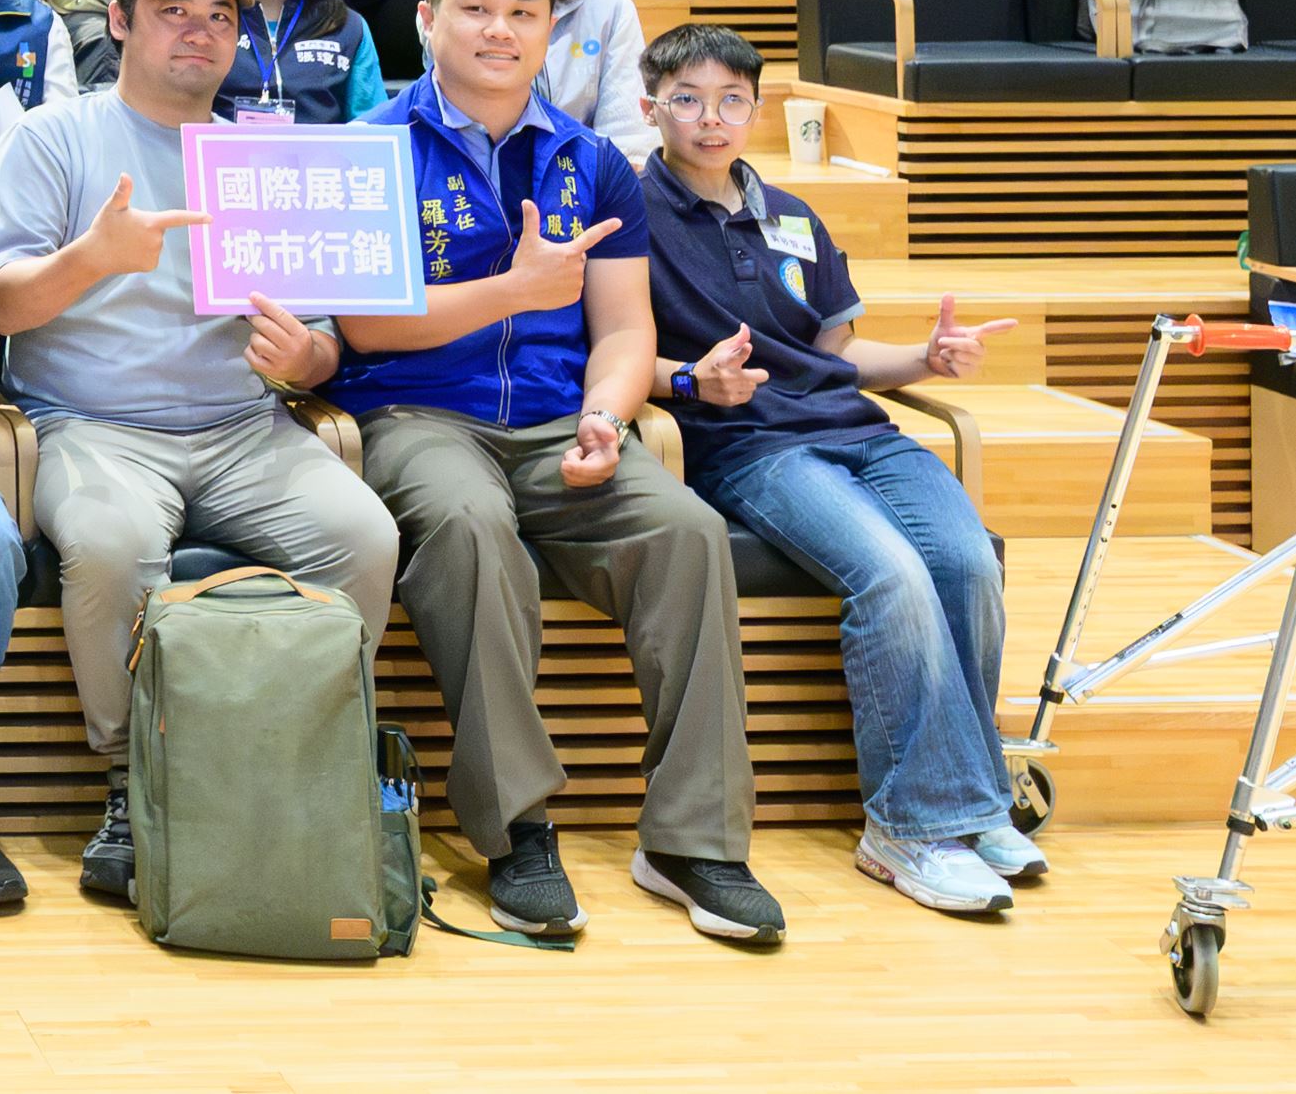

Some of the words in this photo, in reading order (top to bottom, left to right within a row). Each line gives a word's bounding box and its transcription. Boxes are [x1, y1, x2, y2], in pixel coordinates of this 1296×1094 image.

[215, 165, 389, 213] 國際展望
[446, 173, 476, 232] 副主任
[220, 227, 394, 277] 城市行銷
